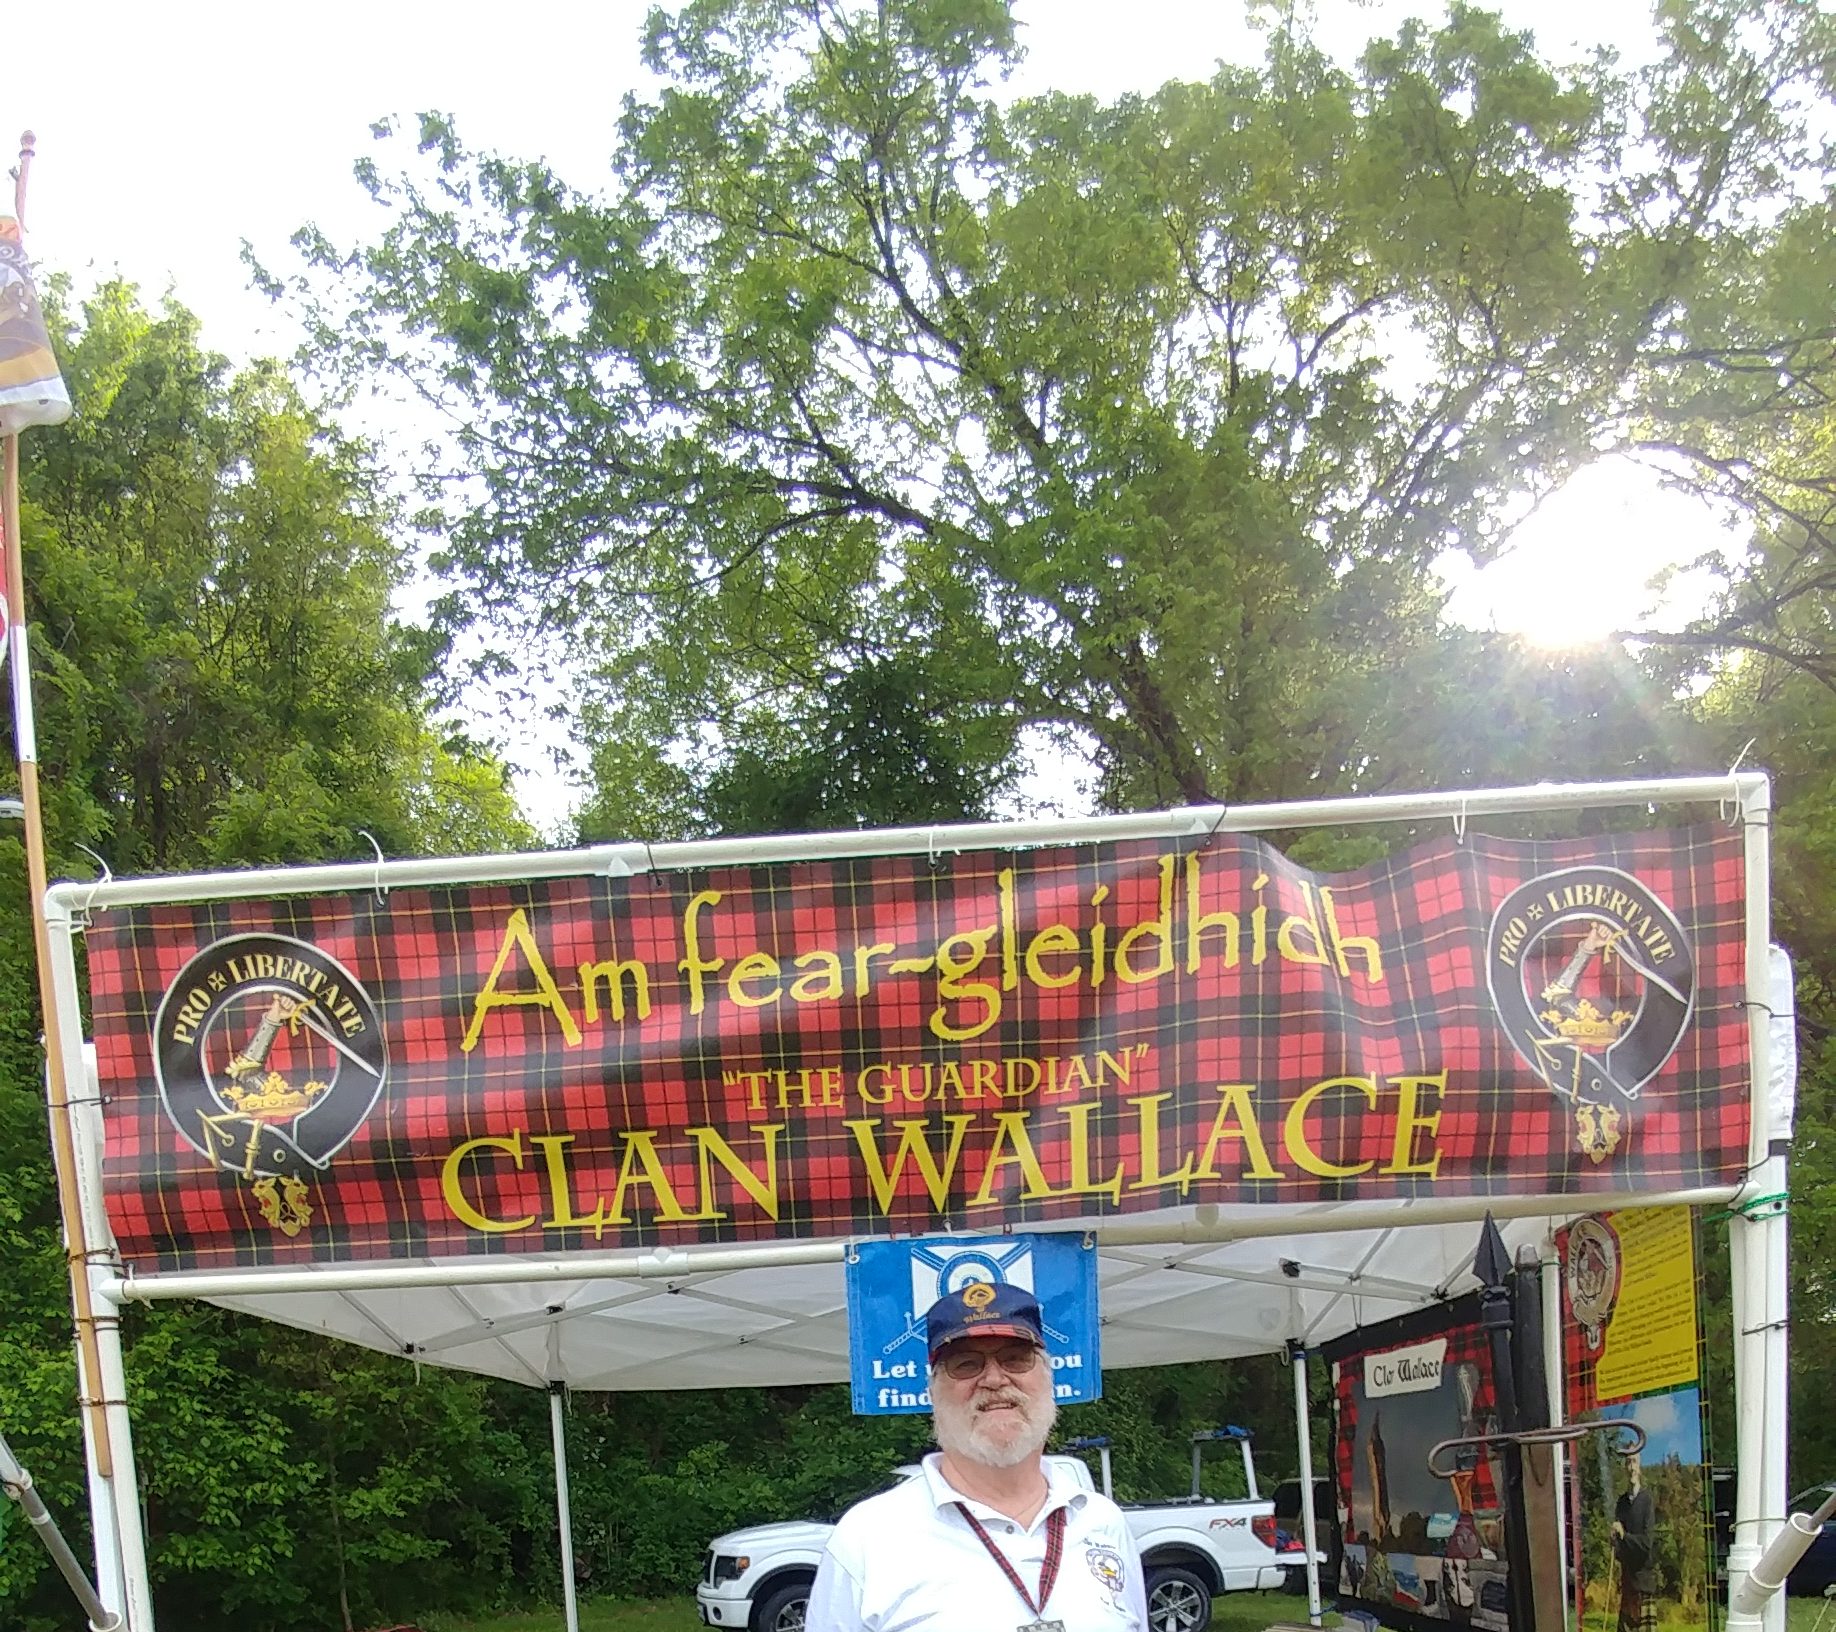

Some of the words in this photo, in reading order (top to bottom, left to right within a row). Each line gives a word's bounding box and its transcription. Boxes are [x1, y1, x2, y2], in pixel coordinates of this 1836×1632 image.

[1500, 917, 1527, 968] PRO
[1546, 884, 1676, 965] LIBERTATE
[173, 986, 212, 1046] PRO
[226, 953, 367, 1039] LIBERTATE
[460, 907, 651, 1053] Am
[441, 1123, 787, 1241] CLAN
[843, 1067, 1448, 1216] WALLACE
[872, 1359, 918, 1379] Let
[1050, 1354, 1084, 1370] ou
[878, 1387, 933, 1408] find
[1208, 1517, 1248, 1529] FX4
